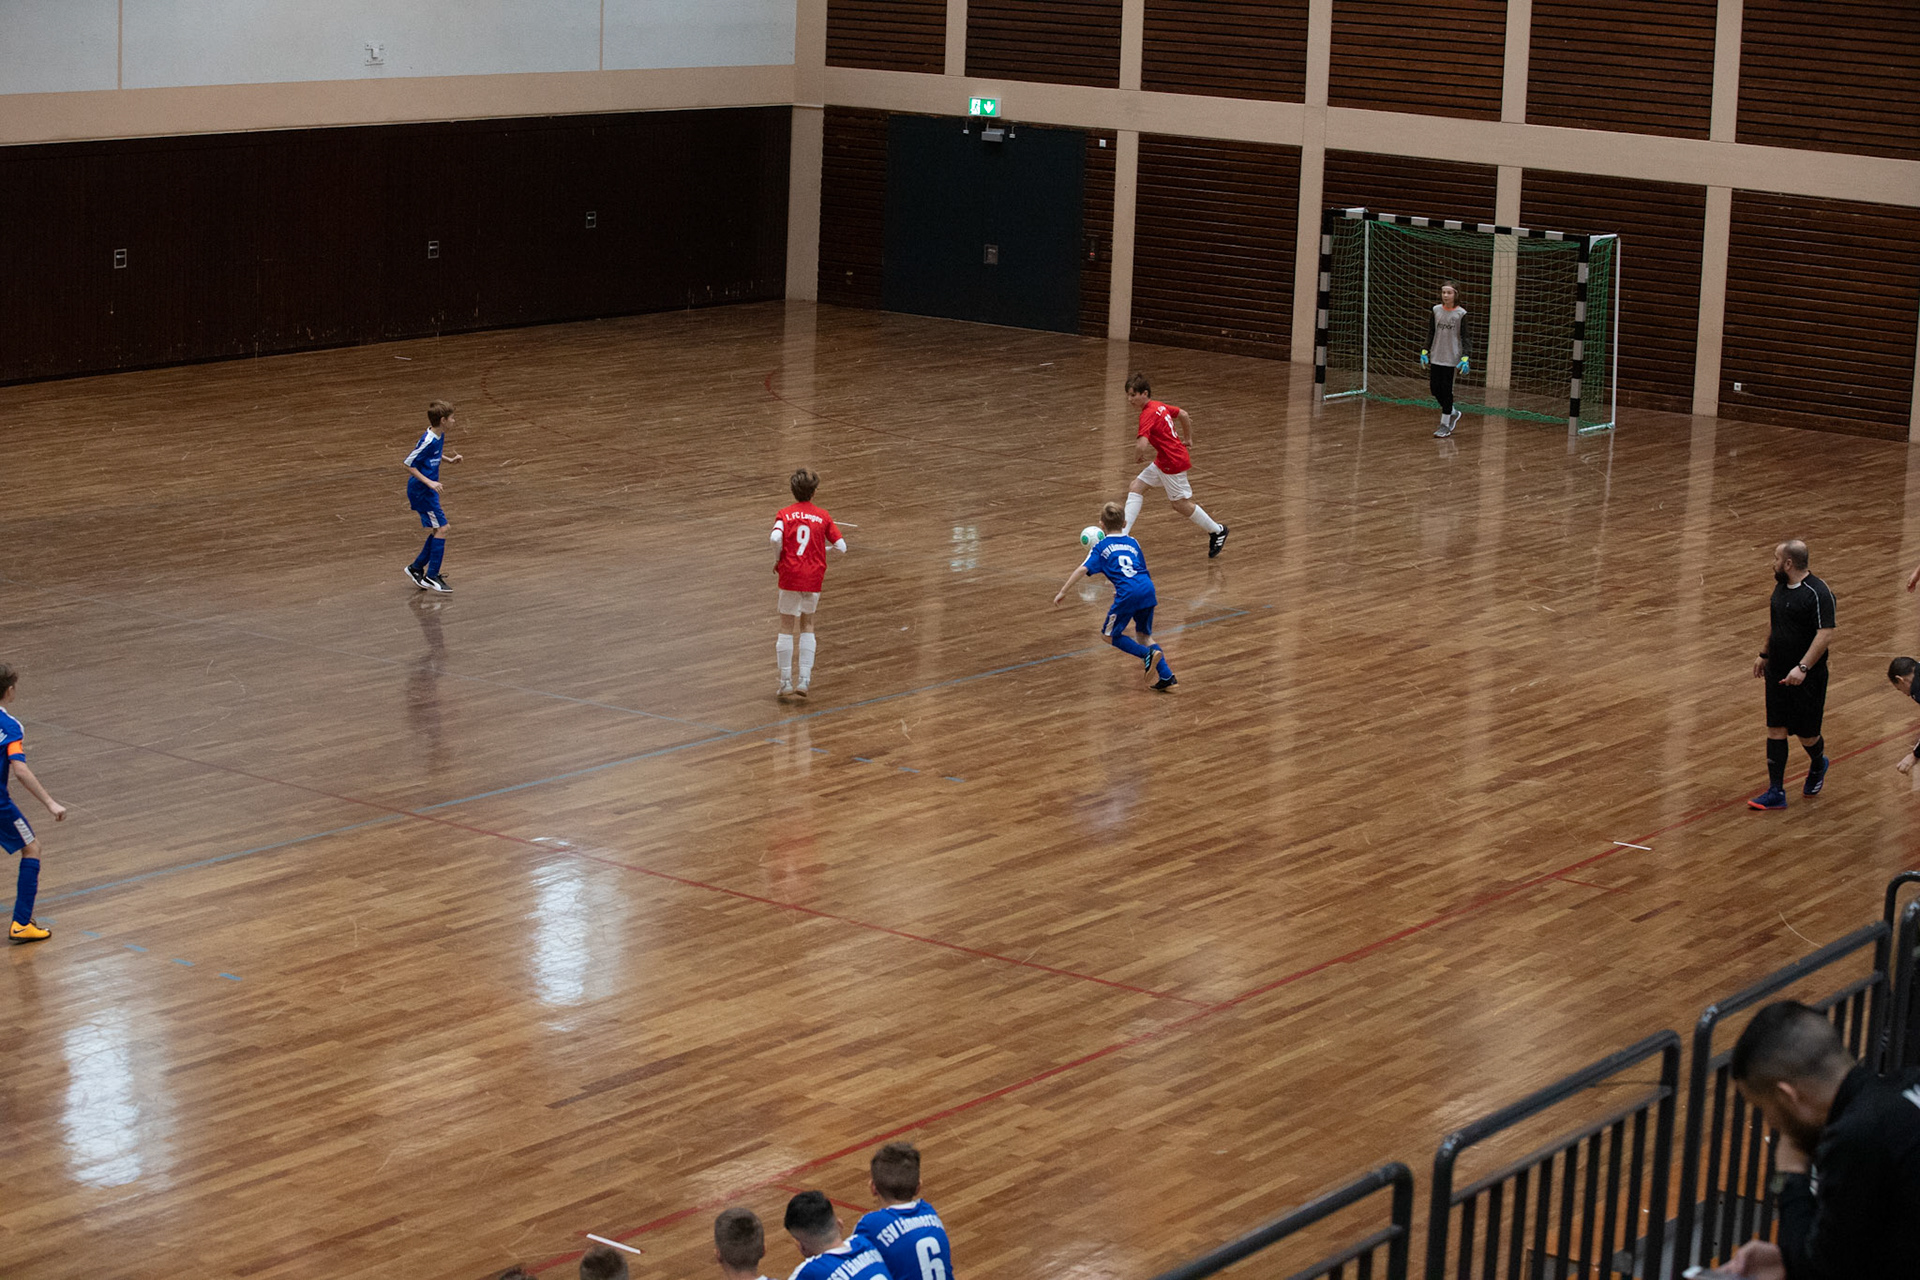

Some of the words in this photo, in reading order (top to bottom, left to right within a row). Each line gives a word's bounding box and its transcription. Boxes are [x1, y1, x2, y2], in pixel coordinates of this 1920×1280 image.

[791, 511, 800, 520] FC
[796, 524, 811, 556] 9
[1118, 554, 1138, 578] 8
[876, 1223, 900, 1248] TSV
[915, 1236, 947, 1280] 6
[826, 1266, 850, 1280] SV
